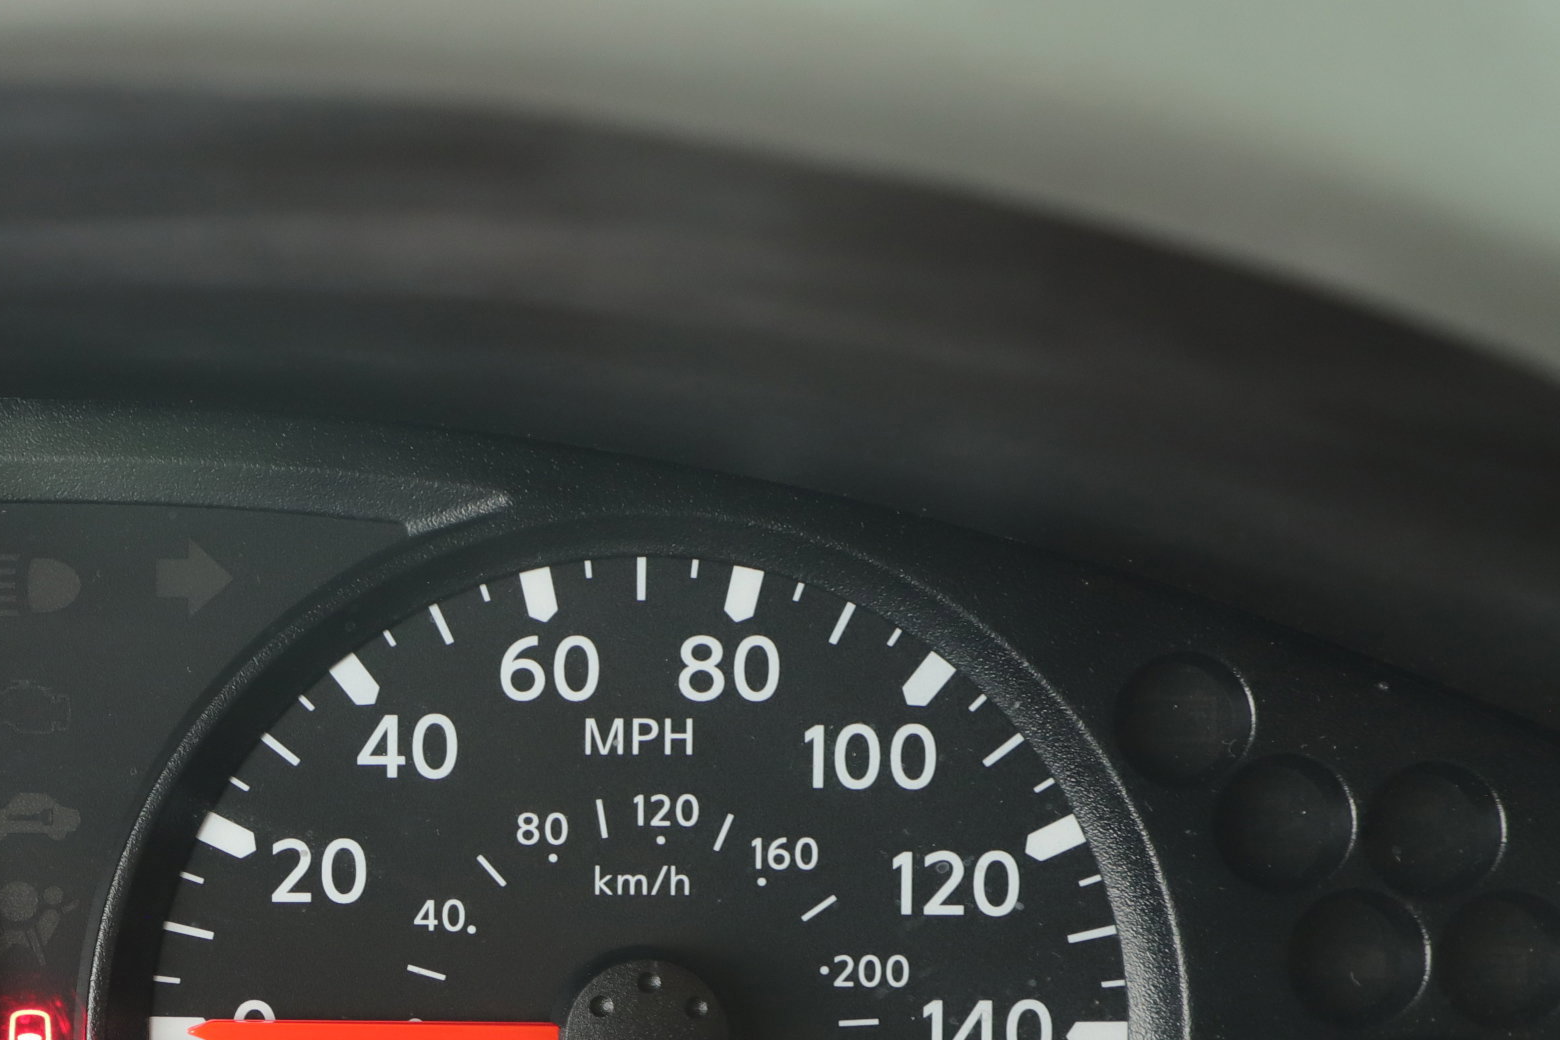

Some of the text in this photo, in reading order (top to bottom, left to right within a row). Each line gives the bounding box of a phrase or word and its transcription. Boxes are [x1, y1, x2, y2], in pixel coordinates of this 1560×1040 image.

[500, 635, 600, 702] 60
[678, 634, 780, 702] 80
[356, 713, 458, 779] 40
[584, 717, 694, 756] MPH
[804, 723, 937, 790] 100
[516, 812, 570, 846] 80
[633, 793, 700, 828] 120
[271, 837, 368, 904] 20
[751, 837, 819, 871] 160
[594, 865, 691, 896] km/h
[892, 850, 1021, 917] 120
[413, 898, 466, 932] 40
[833, 954, 910, 989] 200
